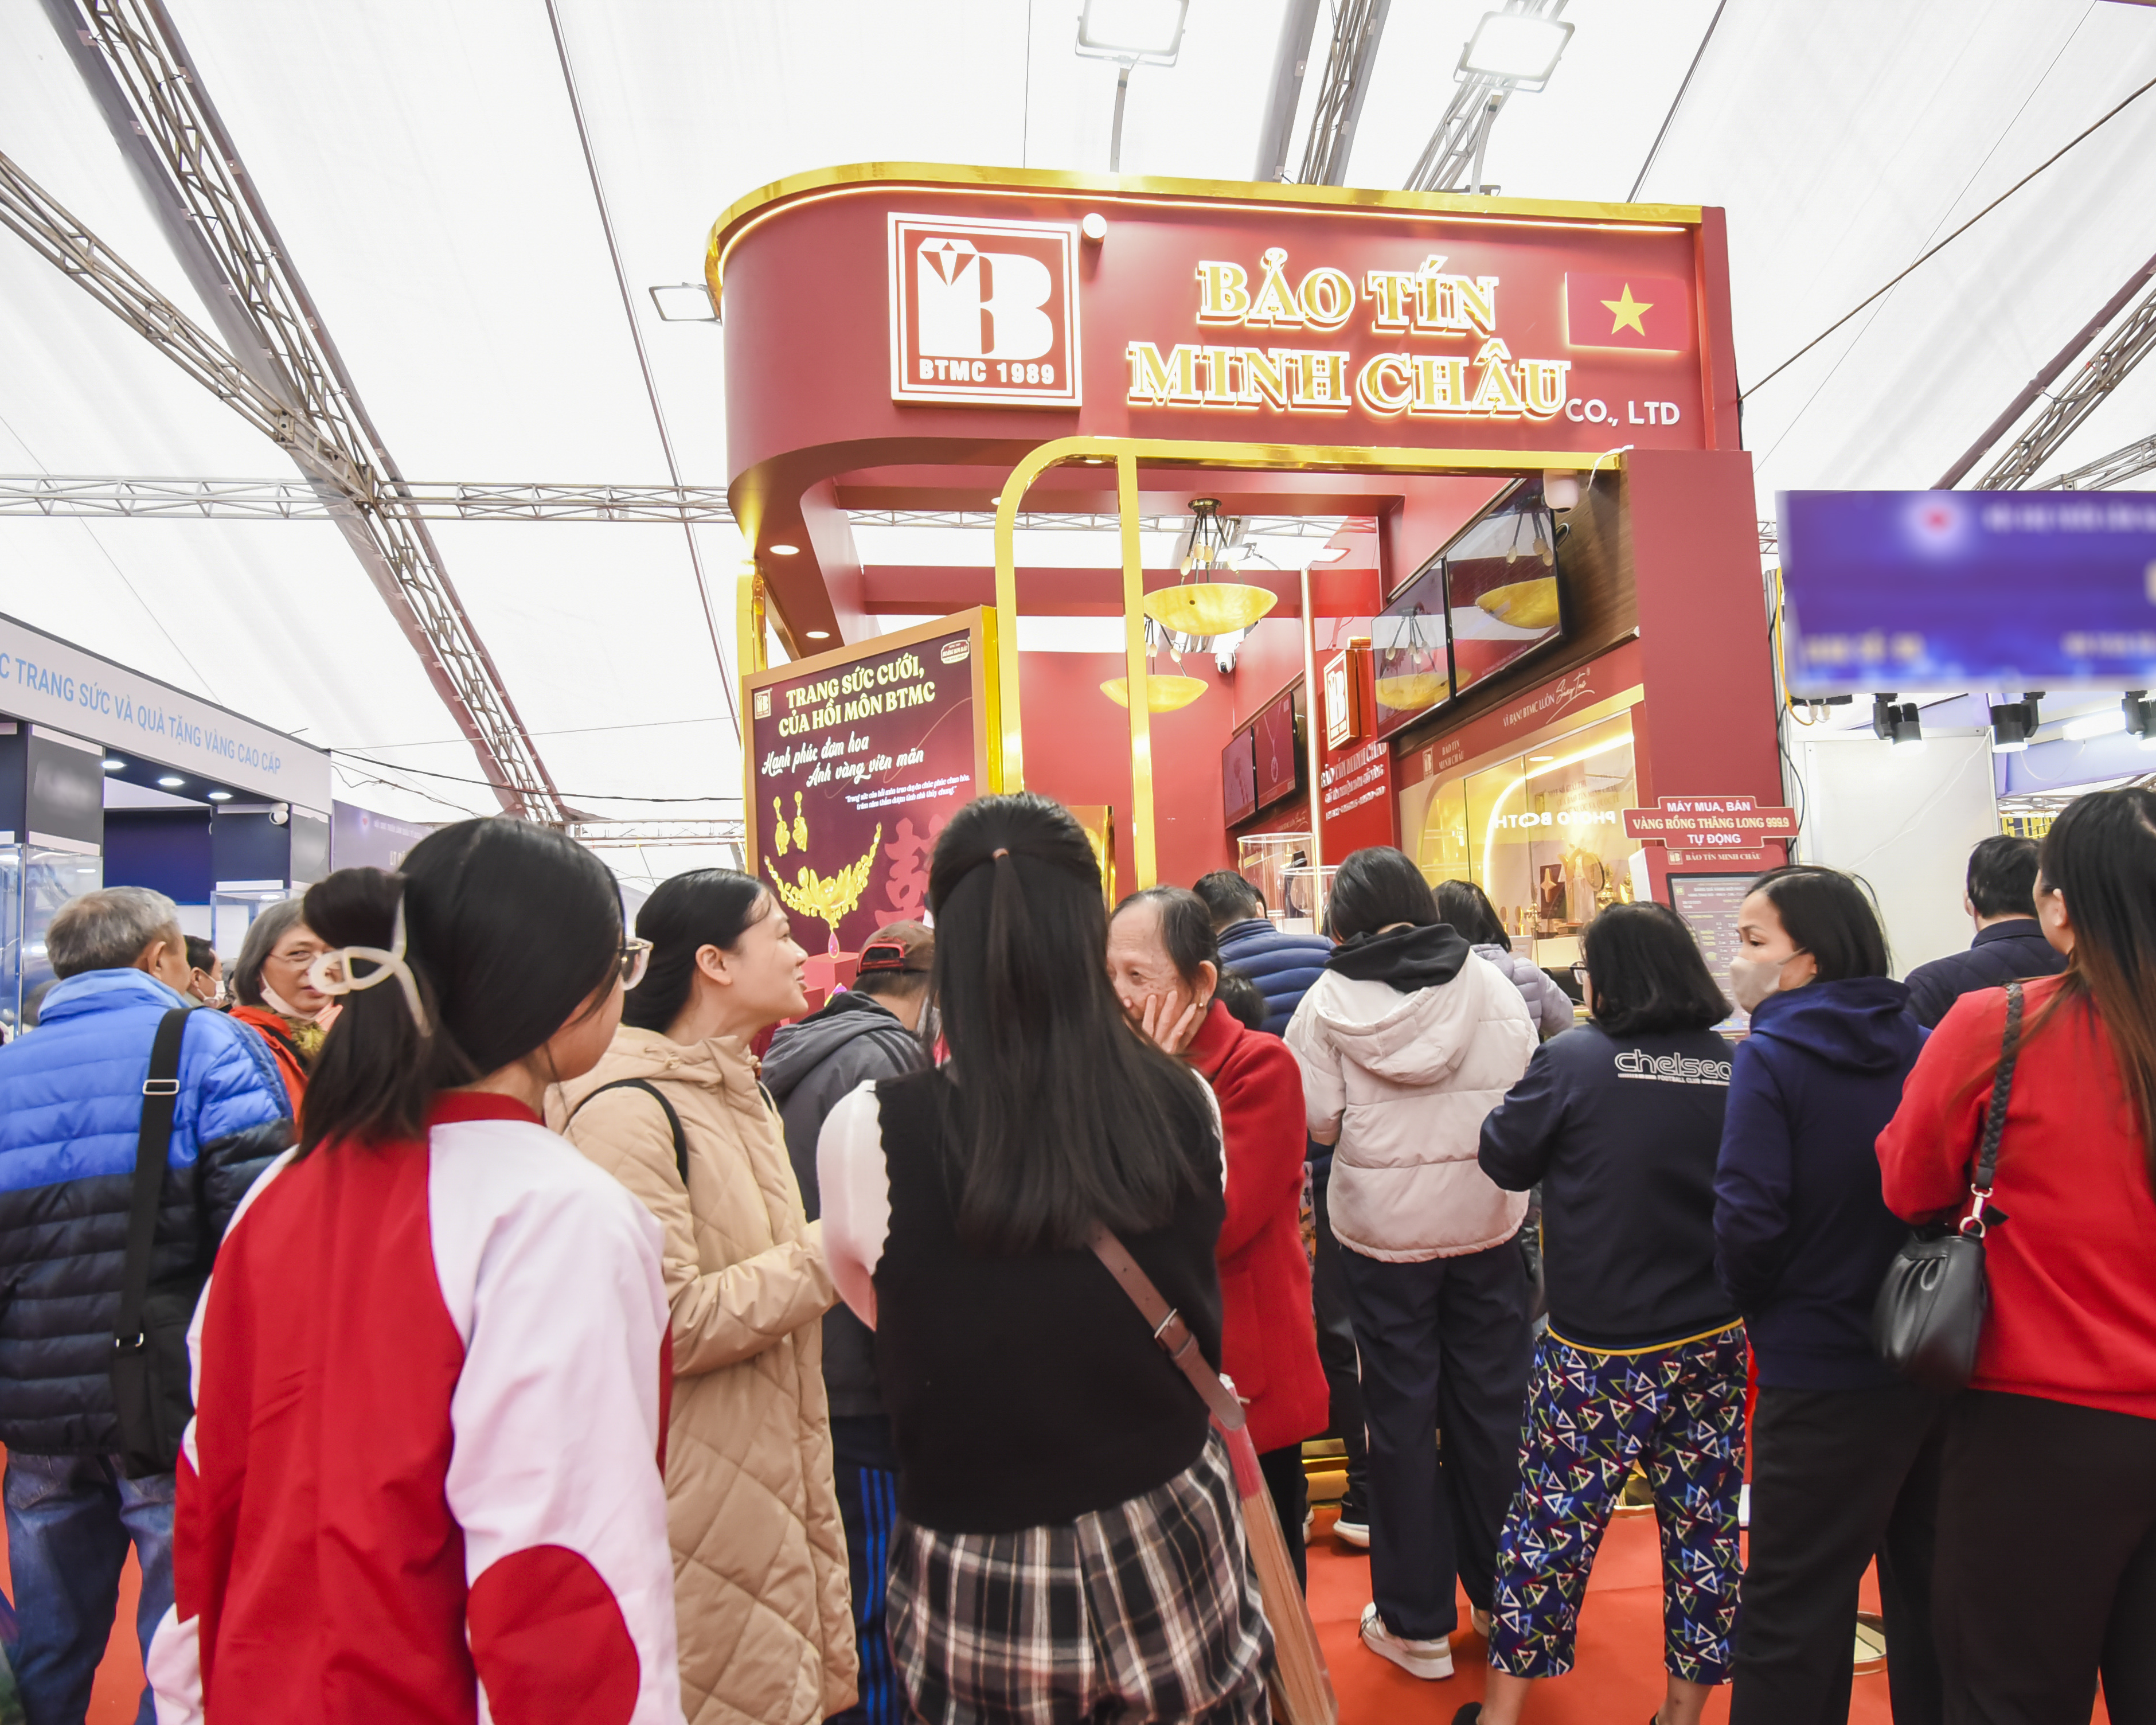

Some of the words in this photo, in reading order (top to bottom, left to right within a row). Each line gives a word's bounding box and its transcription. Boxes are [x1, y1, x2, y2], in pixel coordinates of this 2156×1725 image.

[1196, 248, 1356, 330] BẢO
[1364, 255, 1498, 337] TÍN
[919, 358, 986, 382] BTMC
[997, 362, 1054, 385] 1989
[1127, 341, 1350, 413] MINH
[1357, 339, 1571, 420] CHÂU
[1628, 401, 1680, 425] LTD
[786, 678, 839, 709] TRANG
[842, 666, 874, 695] SỨC
[877, 653, 925, 682] CƯỚI,
[15, 658, 74, 702] TRANG
[79, 682, 110, 715] SỨC
[115, 694, 133, 724] VÀ
[138, 706, 165, 735] QUÀ
[169, 715, 201, 747] TẶNG
[205, 729, 235, 759] VÀNG
[238, 744, 259, 767] CAO
[261, 751, 280, 774] CẤP
[779, 710, 810, 737] CỦA
[812, 698, 841, 729] HỒI
[844, 692, 882, 723] MÔN
[885, 681, 935, 712] BTMC
[1523, 701, 1538, 718] BTMC
[792, 742, 818, 773] phúc
[847, 731, 869, 753] hoa
[806, 762, 831, 787] Ánh
[835, 761, 872, 785] vàng
[869, 754, 892, 772] viên
[1667, 800, 1692, 812] MÁY
[1695, 802, 1724, 813] MUA,
[1726, 799, 1751, 811] BÁN
[1632, 815, 1663, 829] VÀNG
[1697, 815, 1735, 829] THĂNG
[1736, 817, 1764, 828] LONG
[1766, 817, 1790, 828] 999.9
[1687, 834, 1704, 846] TỰ
[1706, 833, 1741, 846] ĐỘNG
[1704, 852, 1717, 861] TÍN
[1657, 1074, 1685, 1083] FOOTBALL
